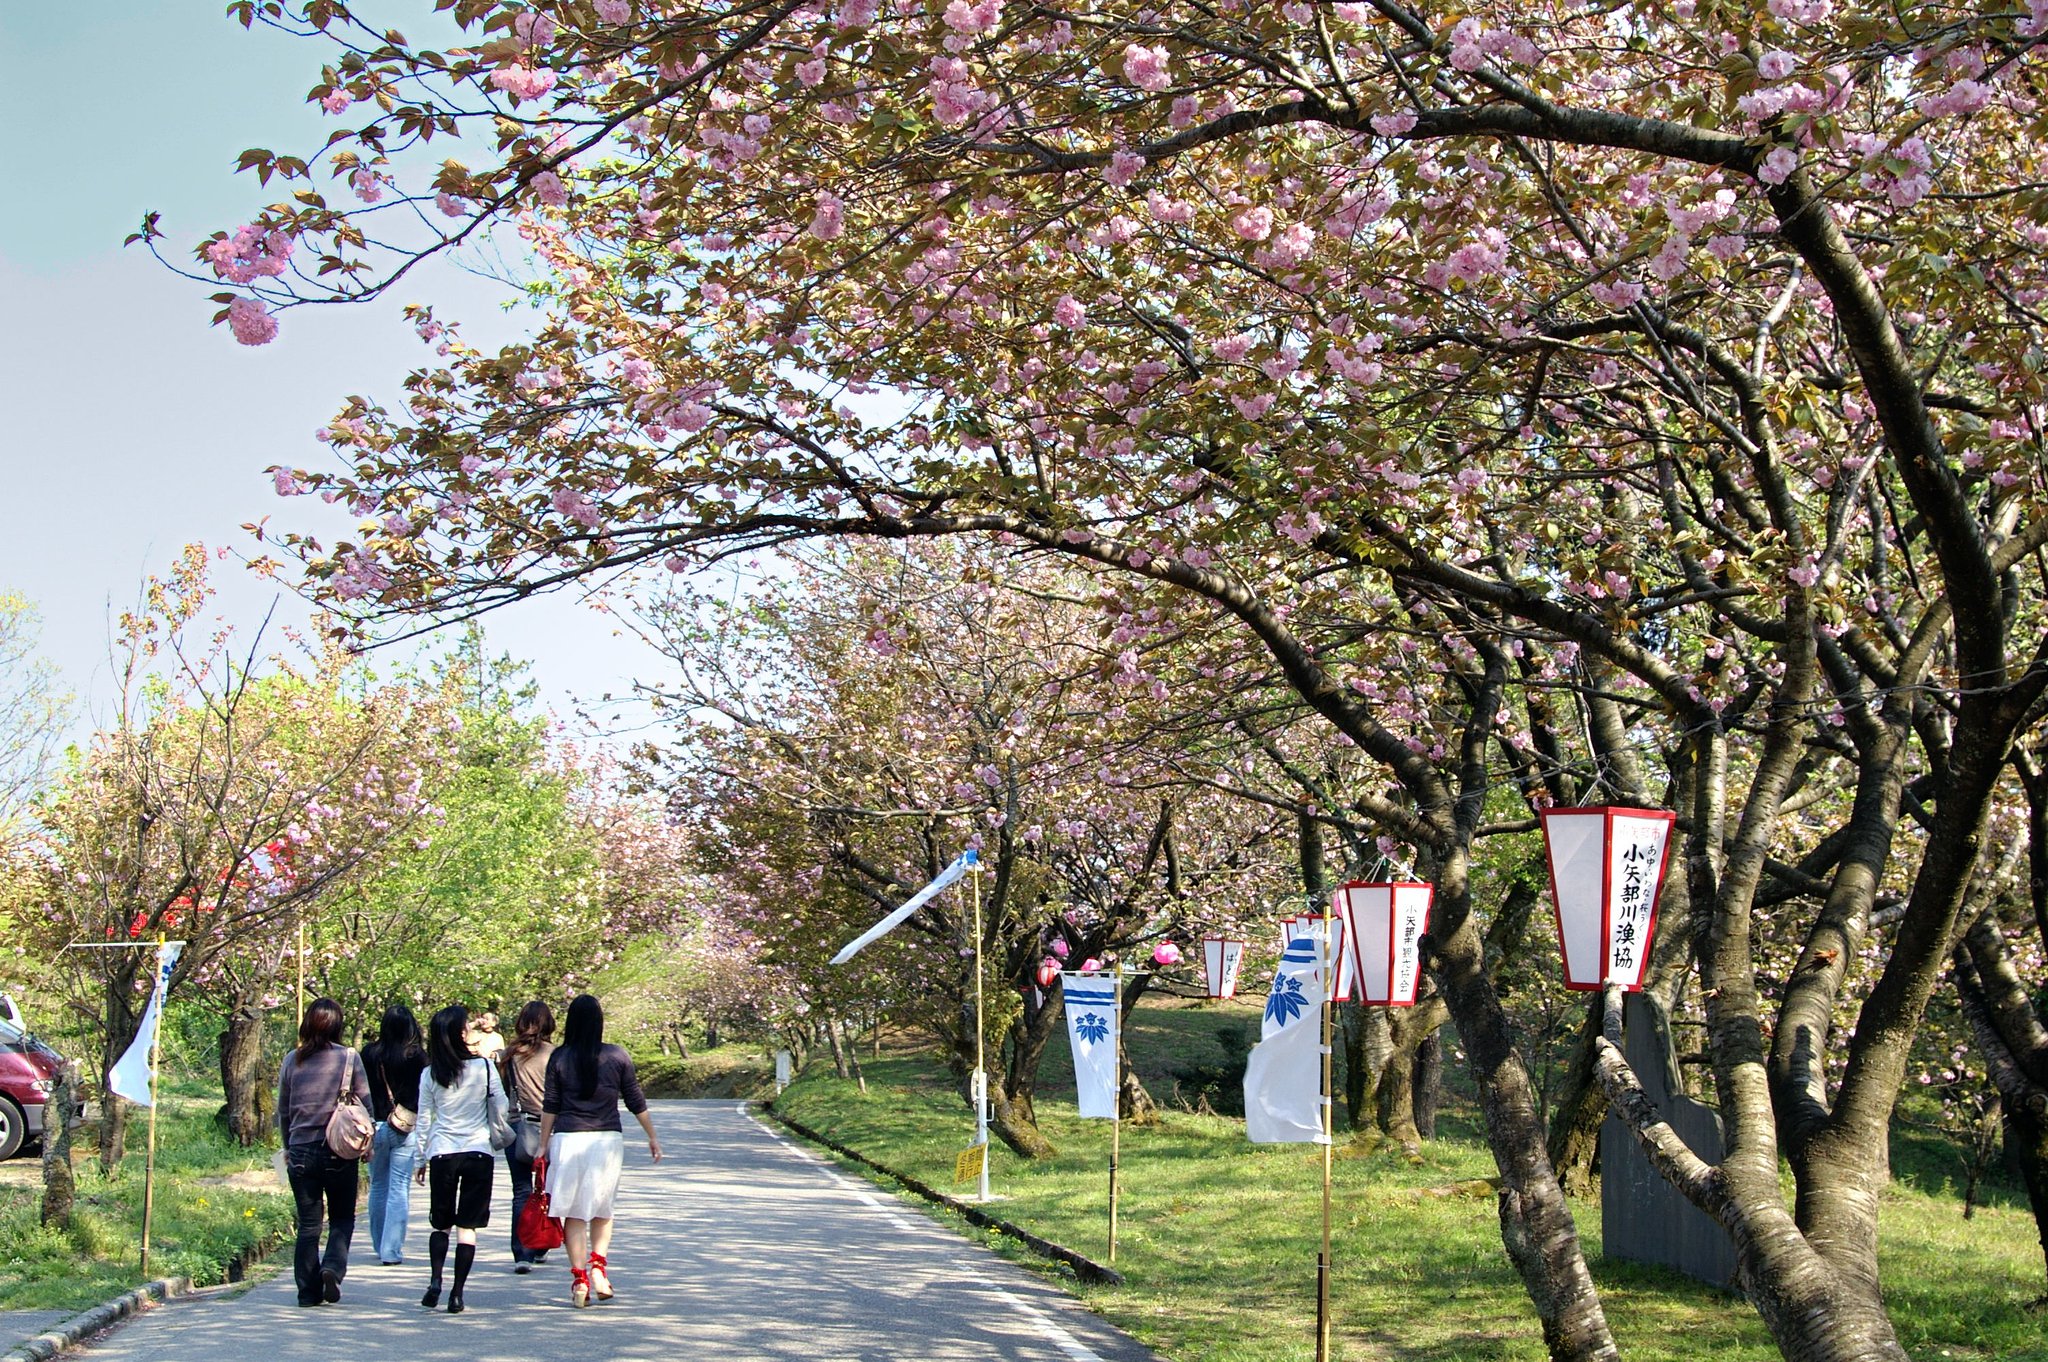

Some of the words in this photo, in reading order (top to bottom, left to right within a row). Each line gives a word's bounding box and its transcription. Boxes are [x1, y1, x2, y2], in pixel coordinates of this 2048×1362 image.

[1613, 843, 1645, 970] 小矢部川漁協
